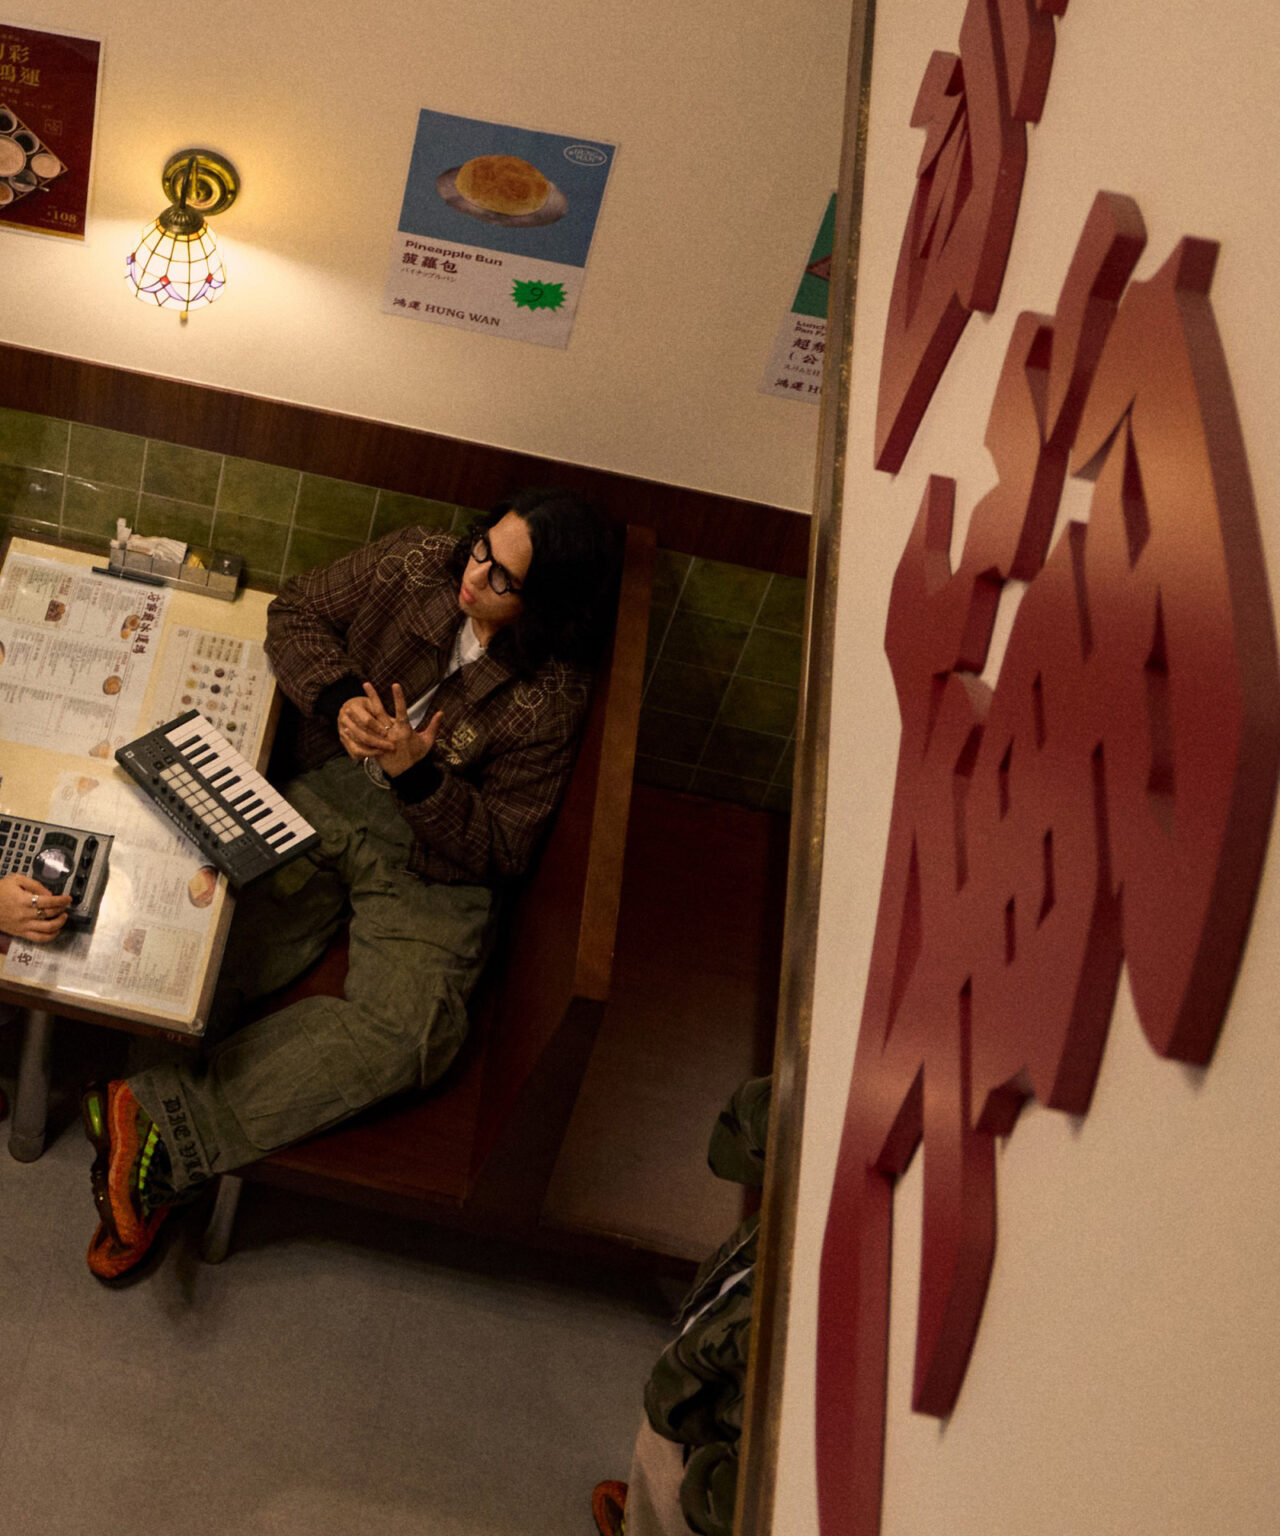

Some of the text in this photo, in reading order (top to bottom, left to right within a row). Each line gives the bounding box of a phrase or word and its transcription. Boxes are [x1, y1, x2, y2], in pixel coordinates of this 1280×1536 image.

[402, 252, 458, 274] 菠蘿包
[405, 239, 503, 267] Pineapple Bun
[425, 303, 501, 326] HUNG WAN
[154, 796, 200, 847] novation
